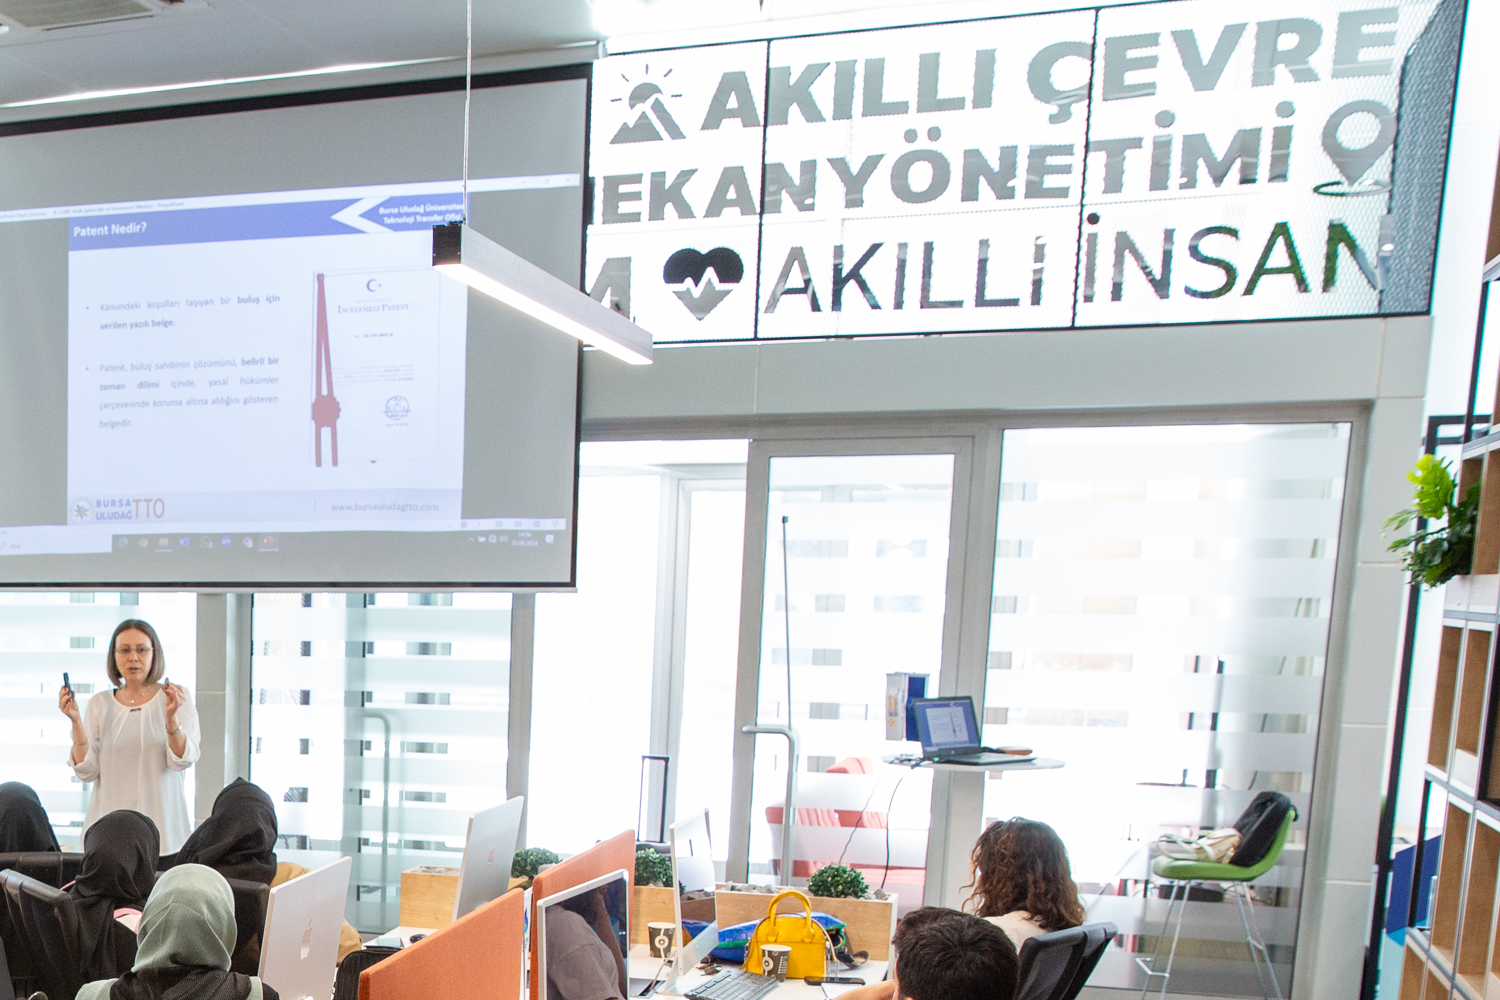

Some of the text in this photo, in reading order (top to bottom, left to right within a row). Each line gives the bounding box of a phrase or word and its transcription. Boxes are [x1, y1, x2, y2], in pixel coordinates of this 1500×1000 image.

[700, 6, 1398, 132] AKILLI ÇEVRE
[73, 221, 147, 237] Patent Nedir?
[763, 213, 1395, 314] AKILLI İNSAN
[100, 294, 280, 311] Kanundaki koşulları taşıyan bir buluş için
[100, 318, 175, 330] verilen yazılı belge.
[100, 356, 279, 373] Patent, buluş sahibinin çözümünü, belirli bir
[100, 376, 279, 391] zaman dilimi içinde, yasal hükümler
[99, 401, 150, 411] çerçevesinde
[153, 398, 183, 408] koruma
[186, 397, 208, 406] altına
[243, 394, 278, 406] gösteren
[99, 419, 132, 430] belgedir.
[96, 499, 131, 508] BURSA
[132, 498, 165, 519] TTO
[331, 502, 440, 513] www.bursauludagtto.com
[96, 509, 133, 521] ULUDAĞ
